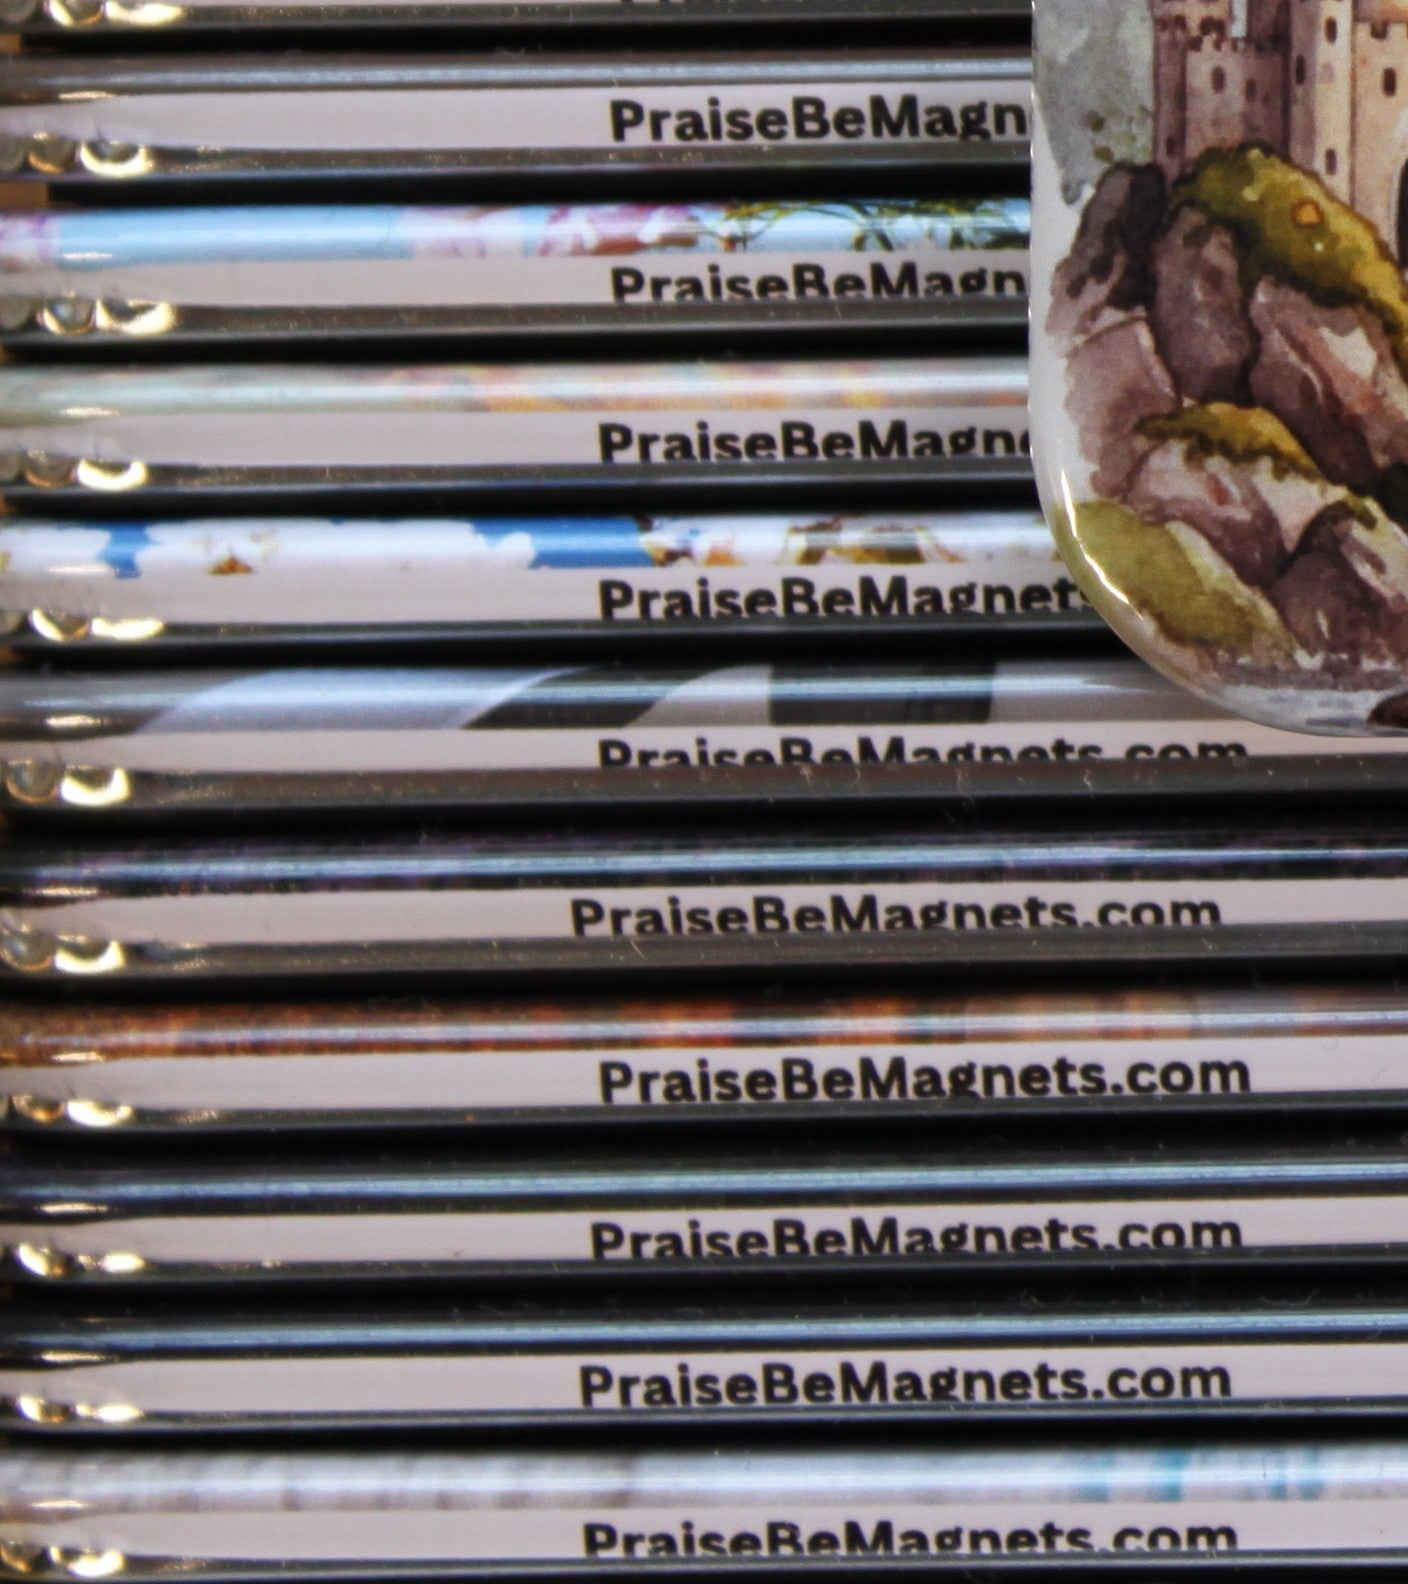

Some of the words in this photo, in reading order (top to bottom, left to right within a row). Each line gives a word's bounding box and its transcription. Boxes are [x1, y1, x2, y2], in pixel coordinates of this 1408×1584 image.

[609, 94, 1032, 143] PraiseBeMagn
[610, 262, 1028, 303] PraiseBeMagn
[599, 419, 1031, 464] PraiseBeMagn
[599, 576, 1090, 619] PraiseBeMagnet
[600, 737, 1248, 769] PraiseBeMagnetscom
[571, 894, 1222, 937] PraiseBeMagnets.com
[600, 1056, 1250, 1104] PraiseBeMagnets.com
[591, 1218, 1242, 1258] PraiseBeMagnets.com
[579, 1361, 1231, 1407] PraiseBeMagnets.com
